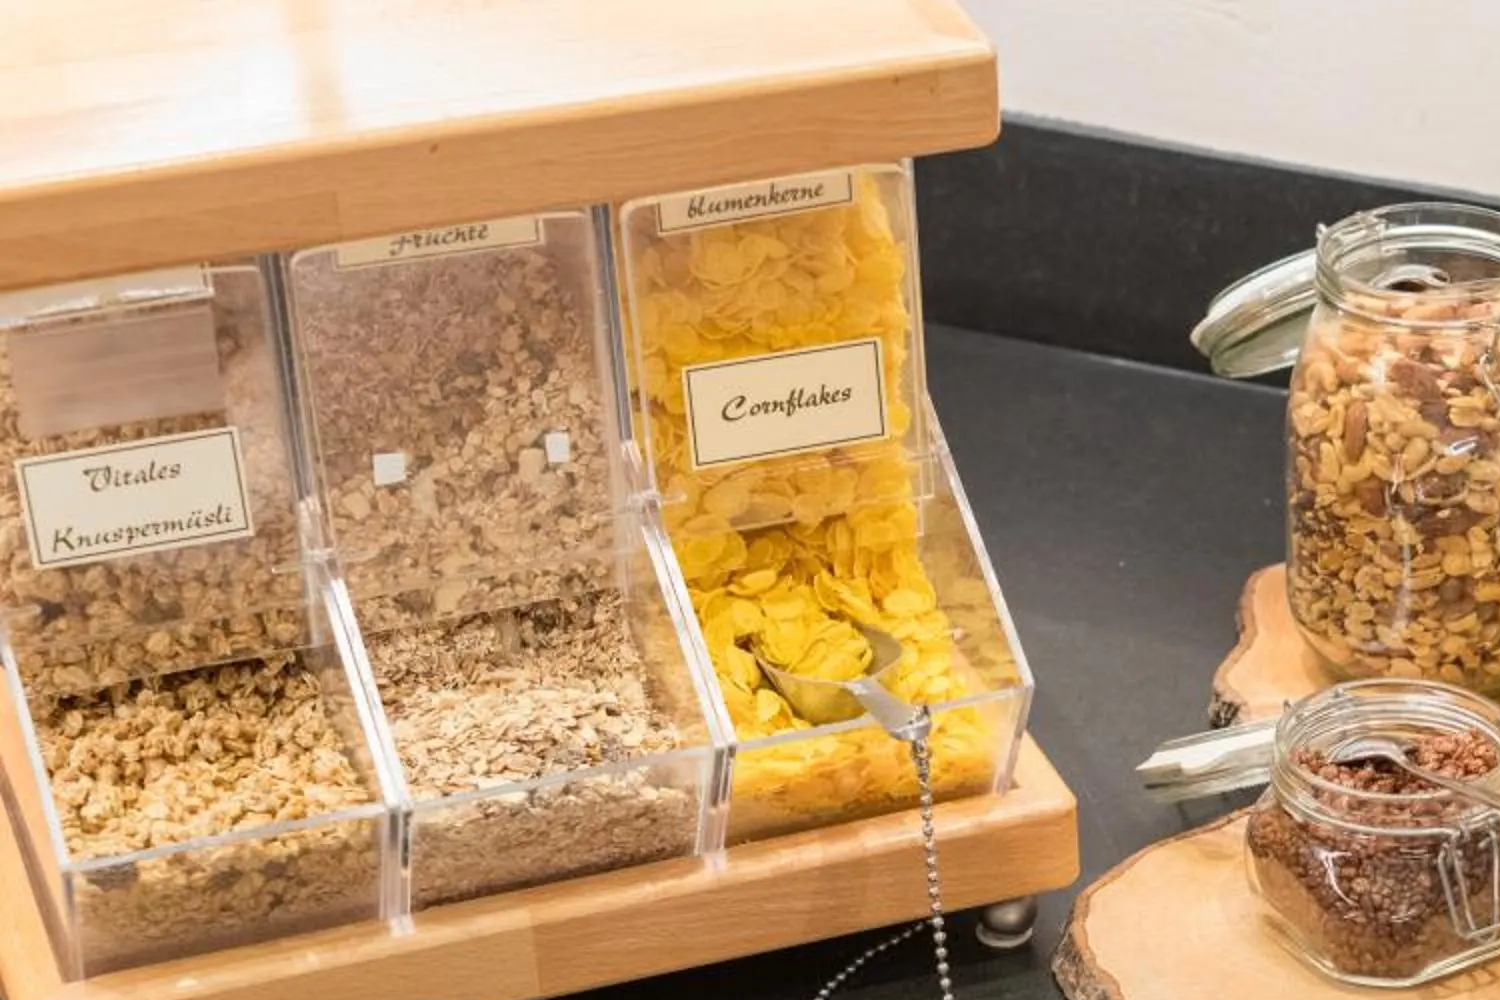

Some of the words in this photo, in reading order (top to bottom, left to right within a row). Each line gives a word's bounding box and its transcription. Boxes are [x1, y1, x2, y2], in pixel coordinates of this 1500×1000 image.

[720, 383, 852, 422] Cornflakes
[82, 460, 182, 493] Vitales
[52, 503, 234, 554] Knuspermüsli
